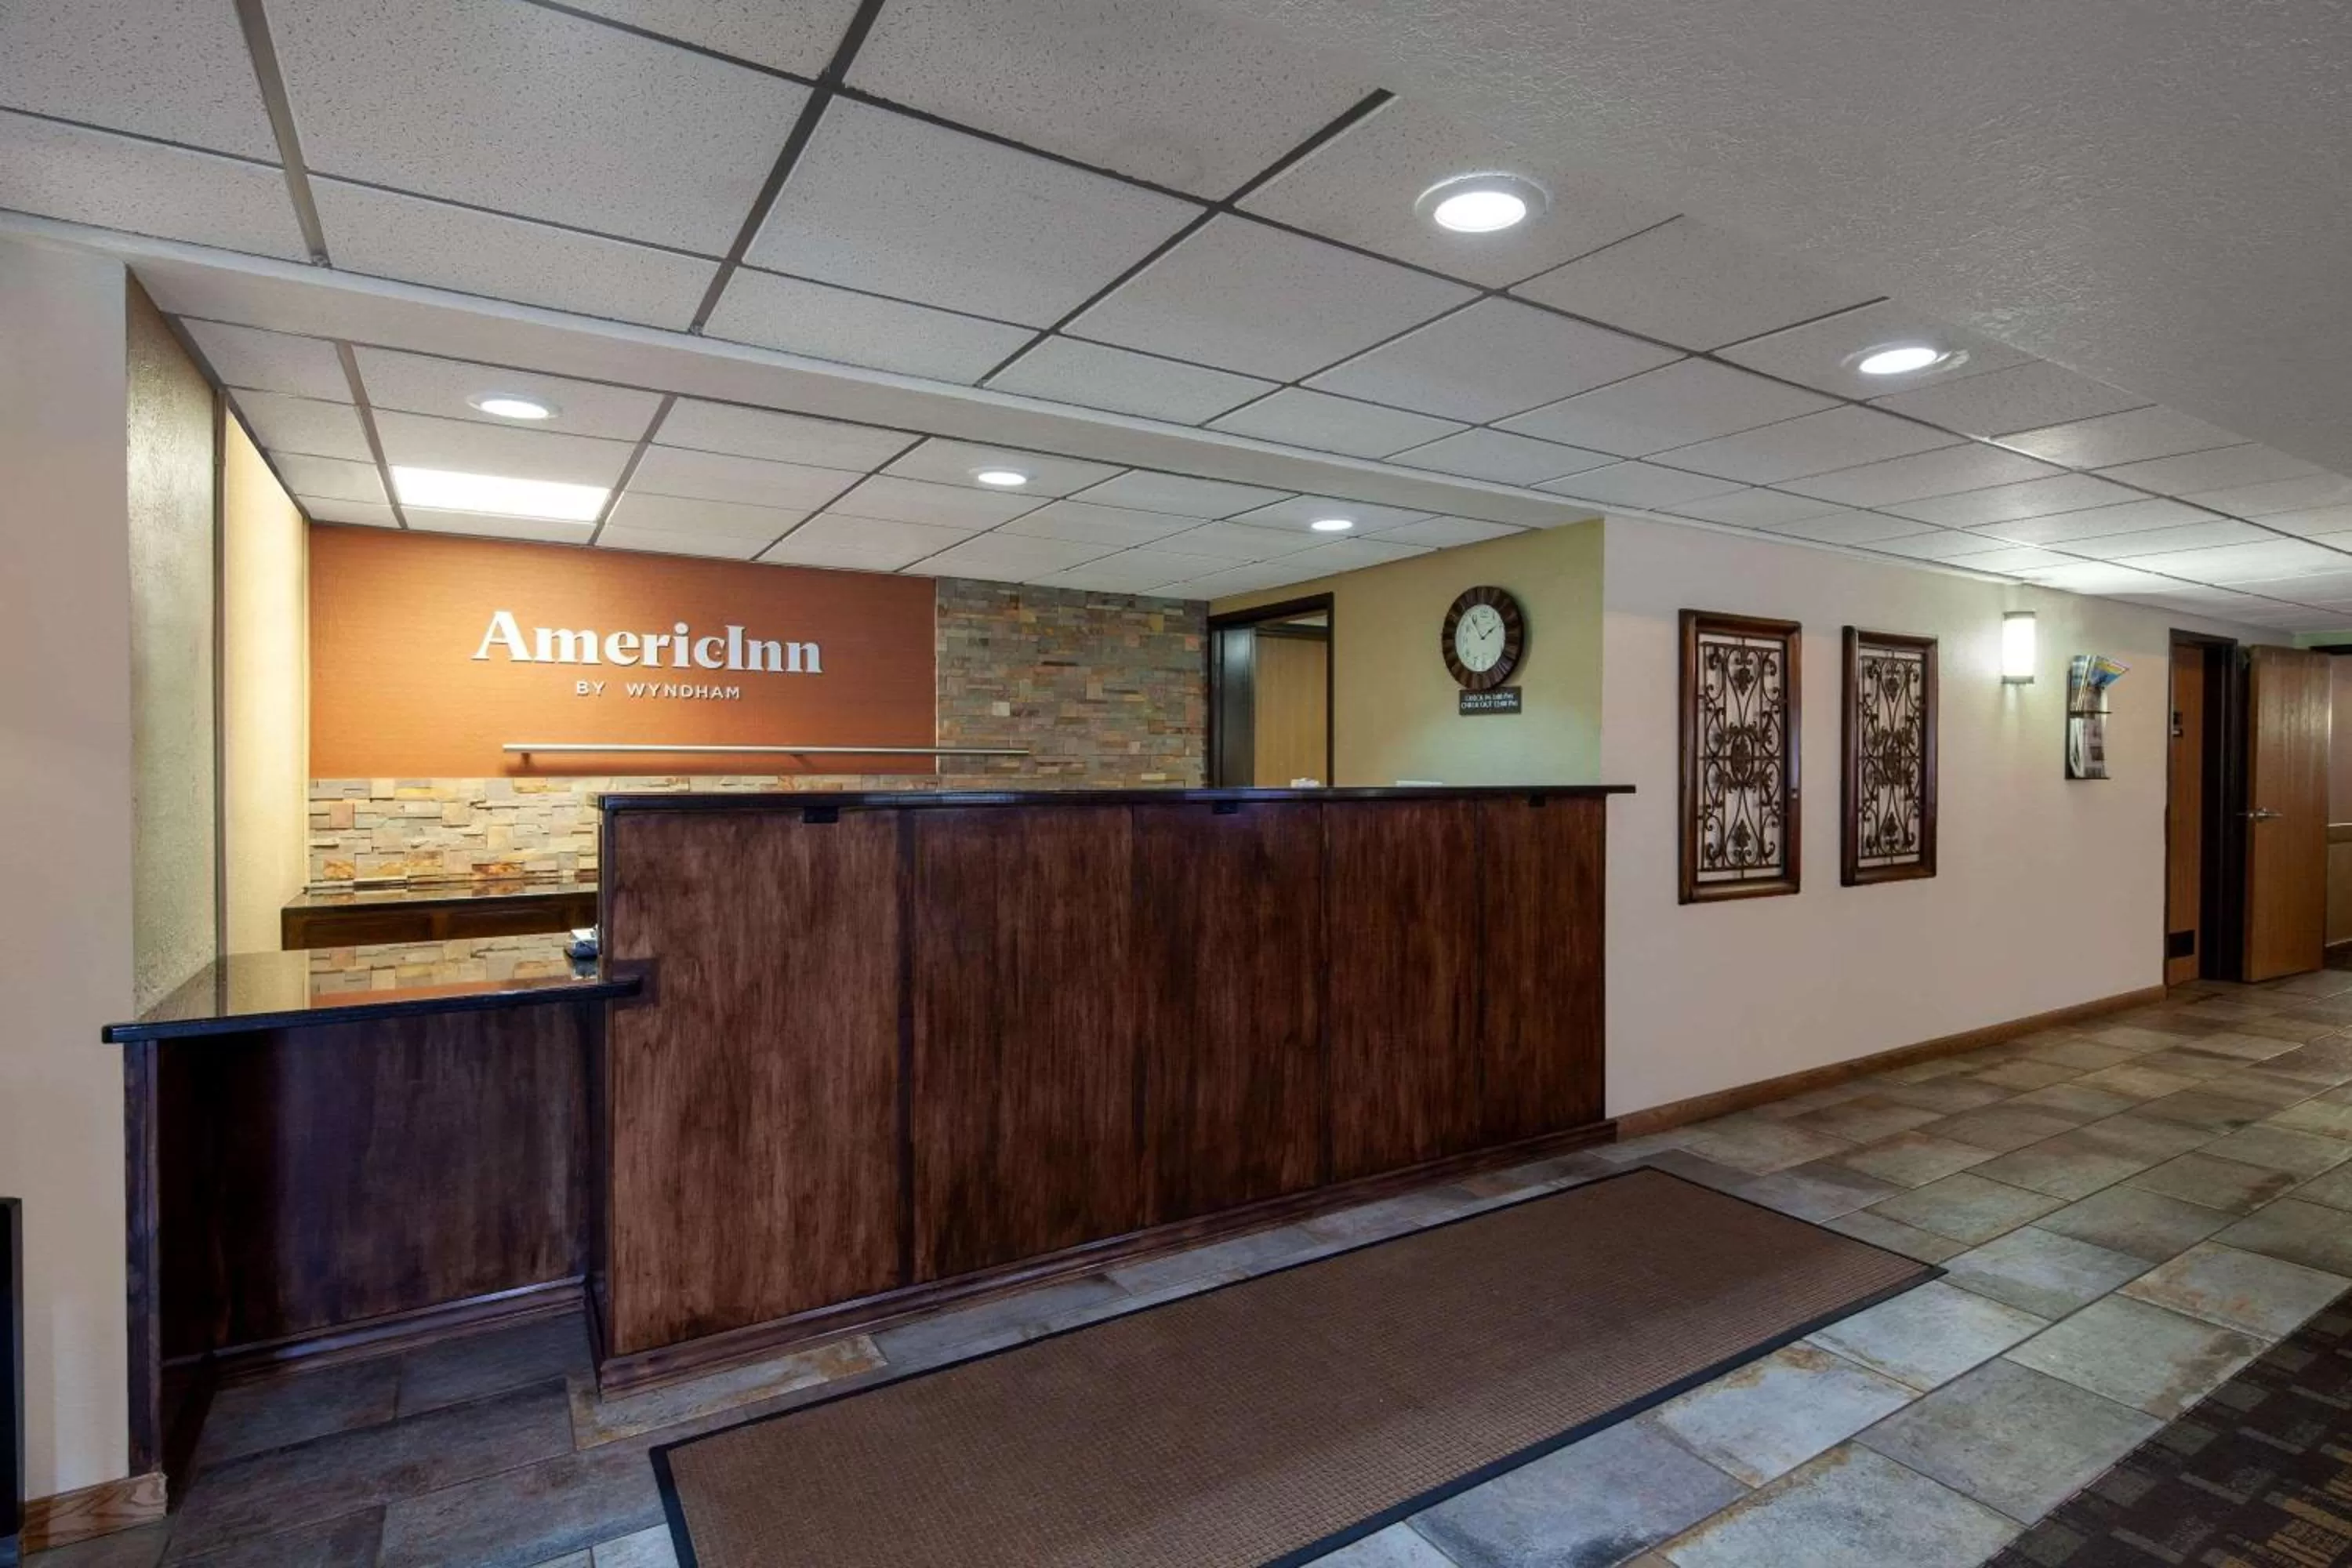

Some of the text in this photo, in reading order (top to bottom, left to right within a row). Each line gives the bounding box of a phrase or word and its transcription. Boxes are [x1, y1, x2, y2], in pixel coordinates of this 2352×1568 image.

[472, 611, 822, 673] AmericInn
[576, 680, 740, 700] BY WYNDHAM
